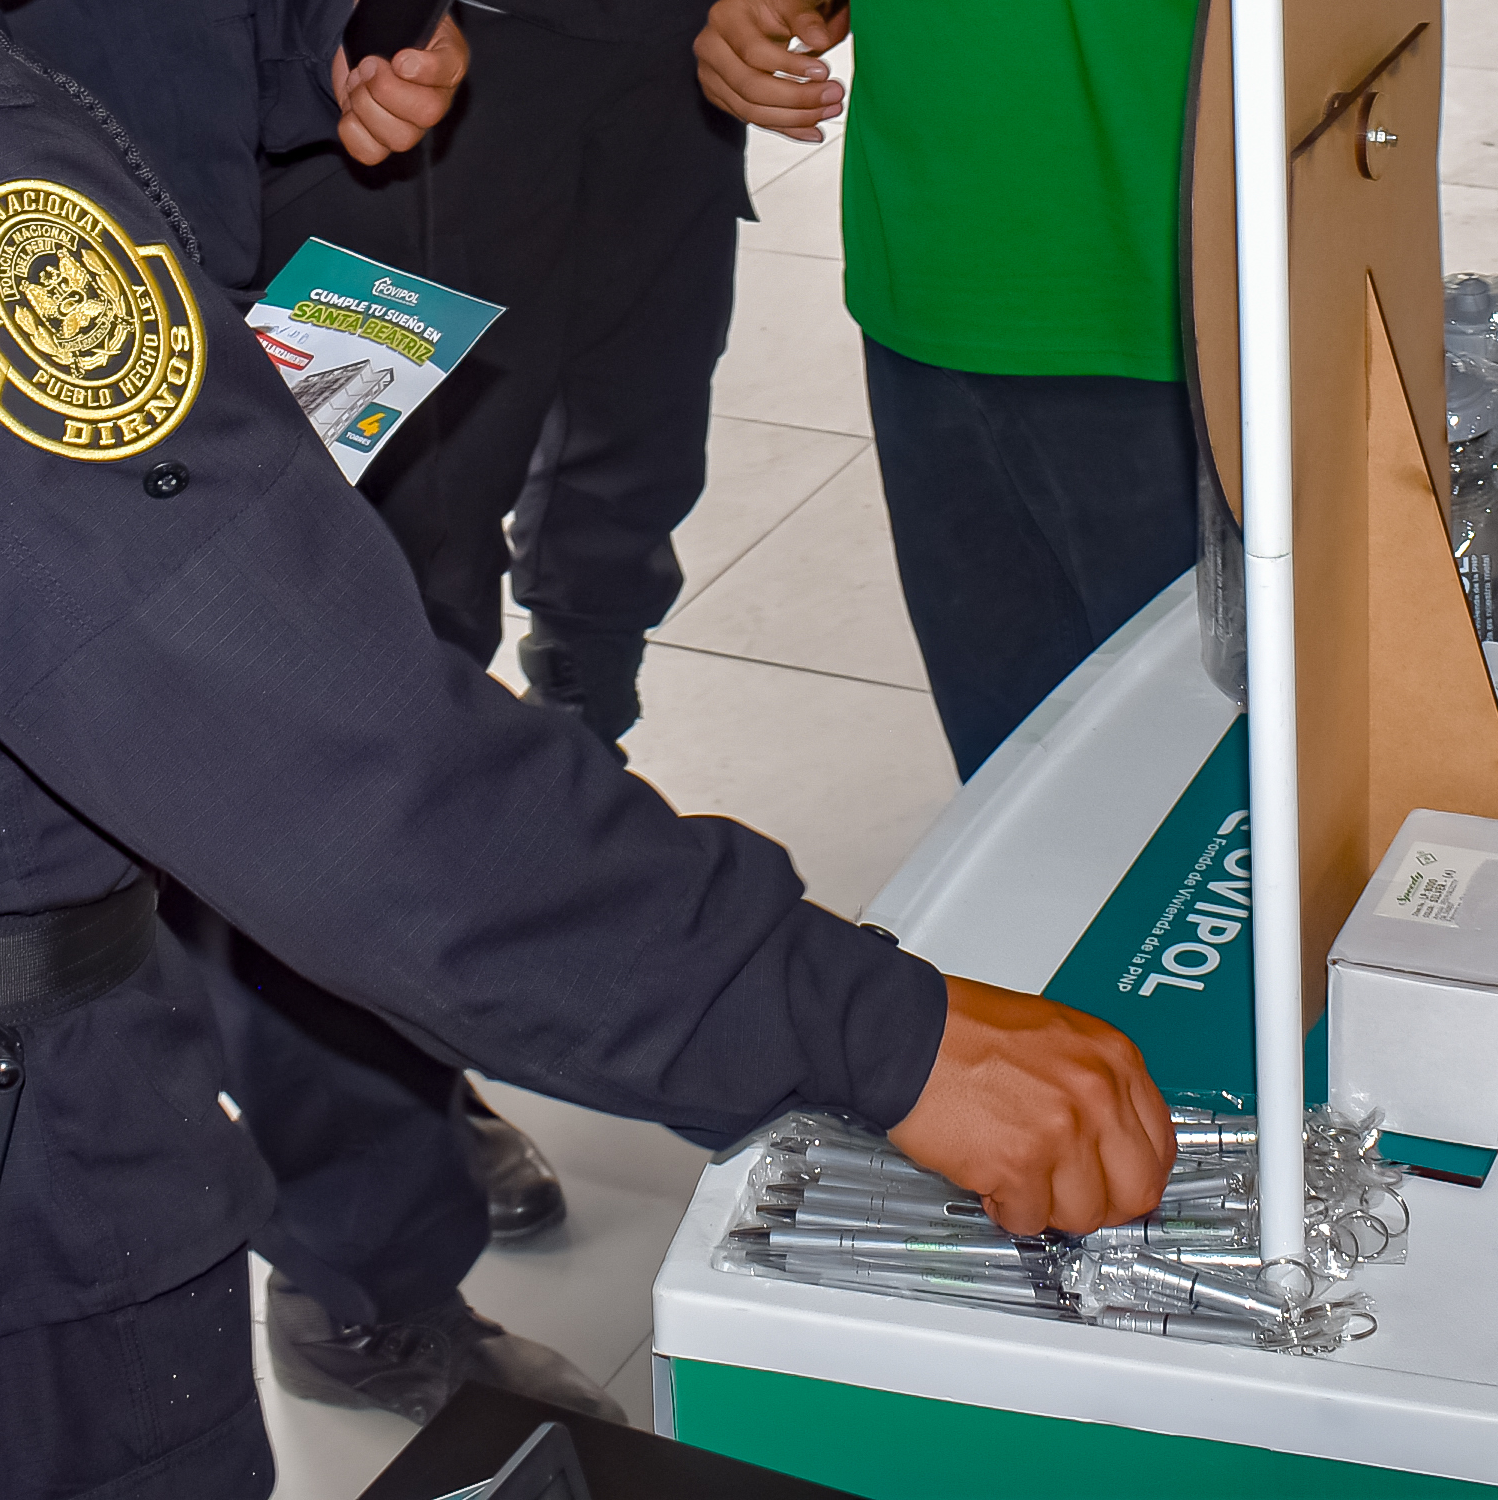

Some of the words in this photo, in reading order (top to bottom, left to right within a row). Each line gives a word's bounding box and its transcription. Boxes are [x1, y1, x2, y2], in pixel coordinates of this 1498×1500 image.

[0, 243, 16, 296] POLICIA
[14, 225, 76, 249] NACIONAL
[130, 283, 156, 322] LEY
[377, 283, 420, 304] FOVIPOL
[291, 301, 362, 333] SANTA
[362, 319, 435, 366] BEATRIZ
[309, 288, 367, 313] CUMPLE
[370, 303, 388, 318] TU
[386, 308, 426, 333] SUEÑO
[423, 327, 443, 344] EN
[118, 333, 159, 398] HECHO
[32, 368, 113, 407] PUEBLO
[62, 324, 191, 446] DIRNOS
[345, 431, 373, 447] TORRES
[356, 411, 387, 437] 4
[1194, 837, 1226, 871] Fondo
[1183, 871, 1202, 886] de
[1396, 871, 1424, 907] Speedy
[1138, 824, 1251, 997] OVIPOL
[1151, 887, 1195, 936] Vivienda
[1131, 952, 1152, 965] la
[1140, 936, 1161, 952] de
[1116, 965, 1143, 993] PNP
[910, 1241, 962, 1252] FOVIPOL
[925, 1272, 977, 1284] FOVIPOL
